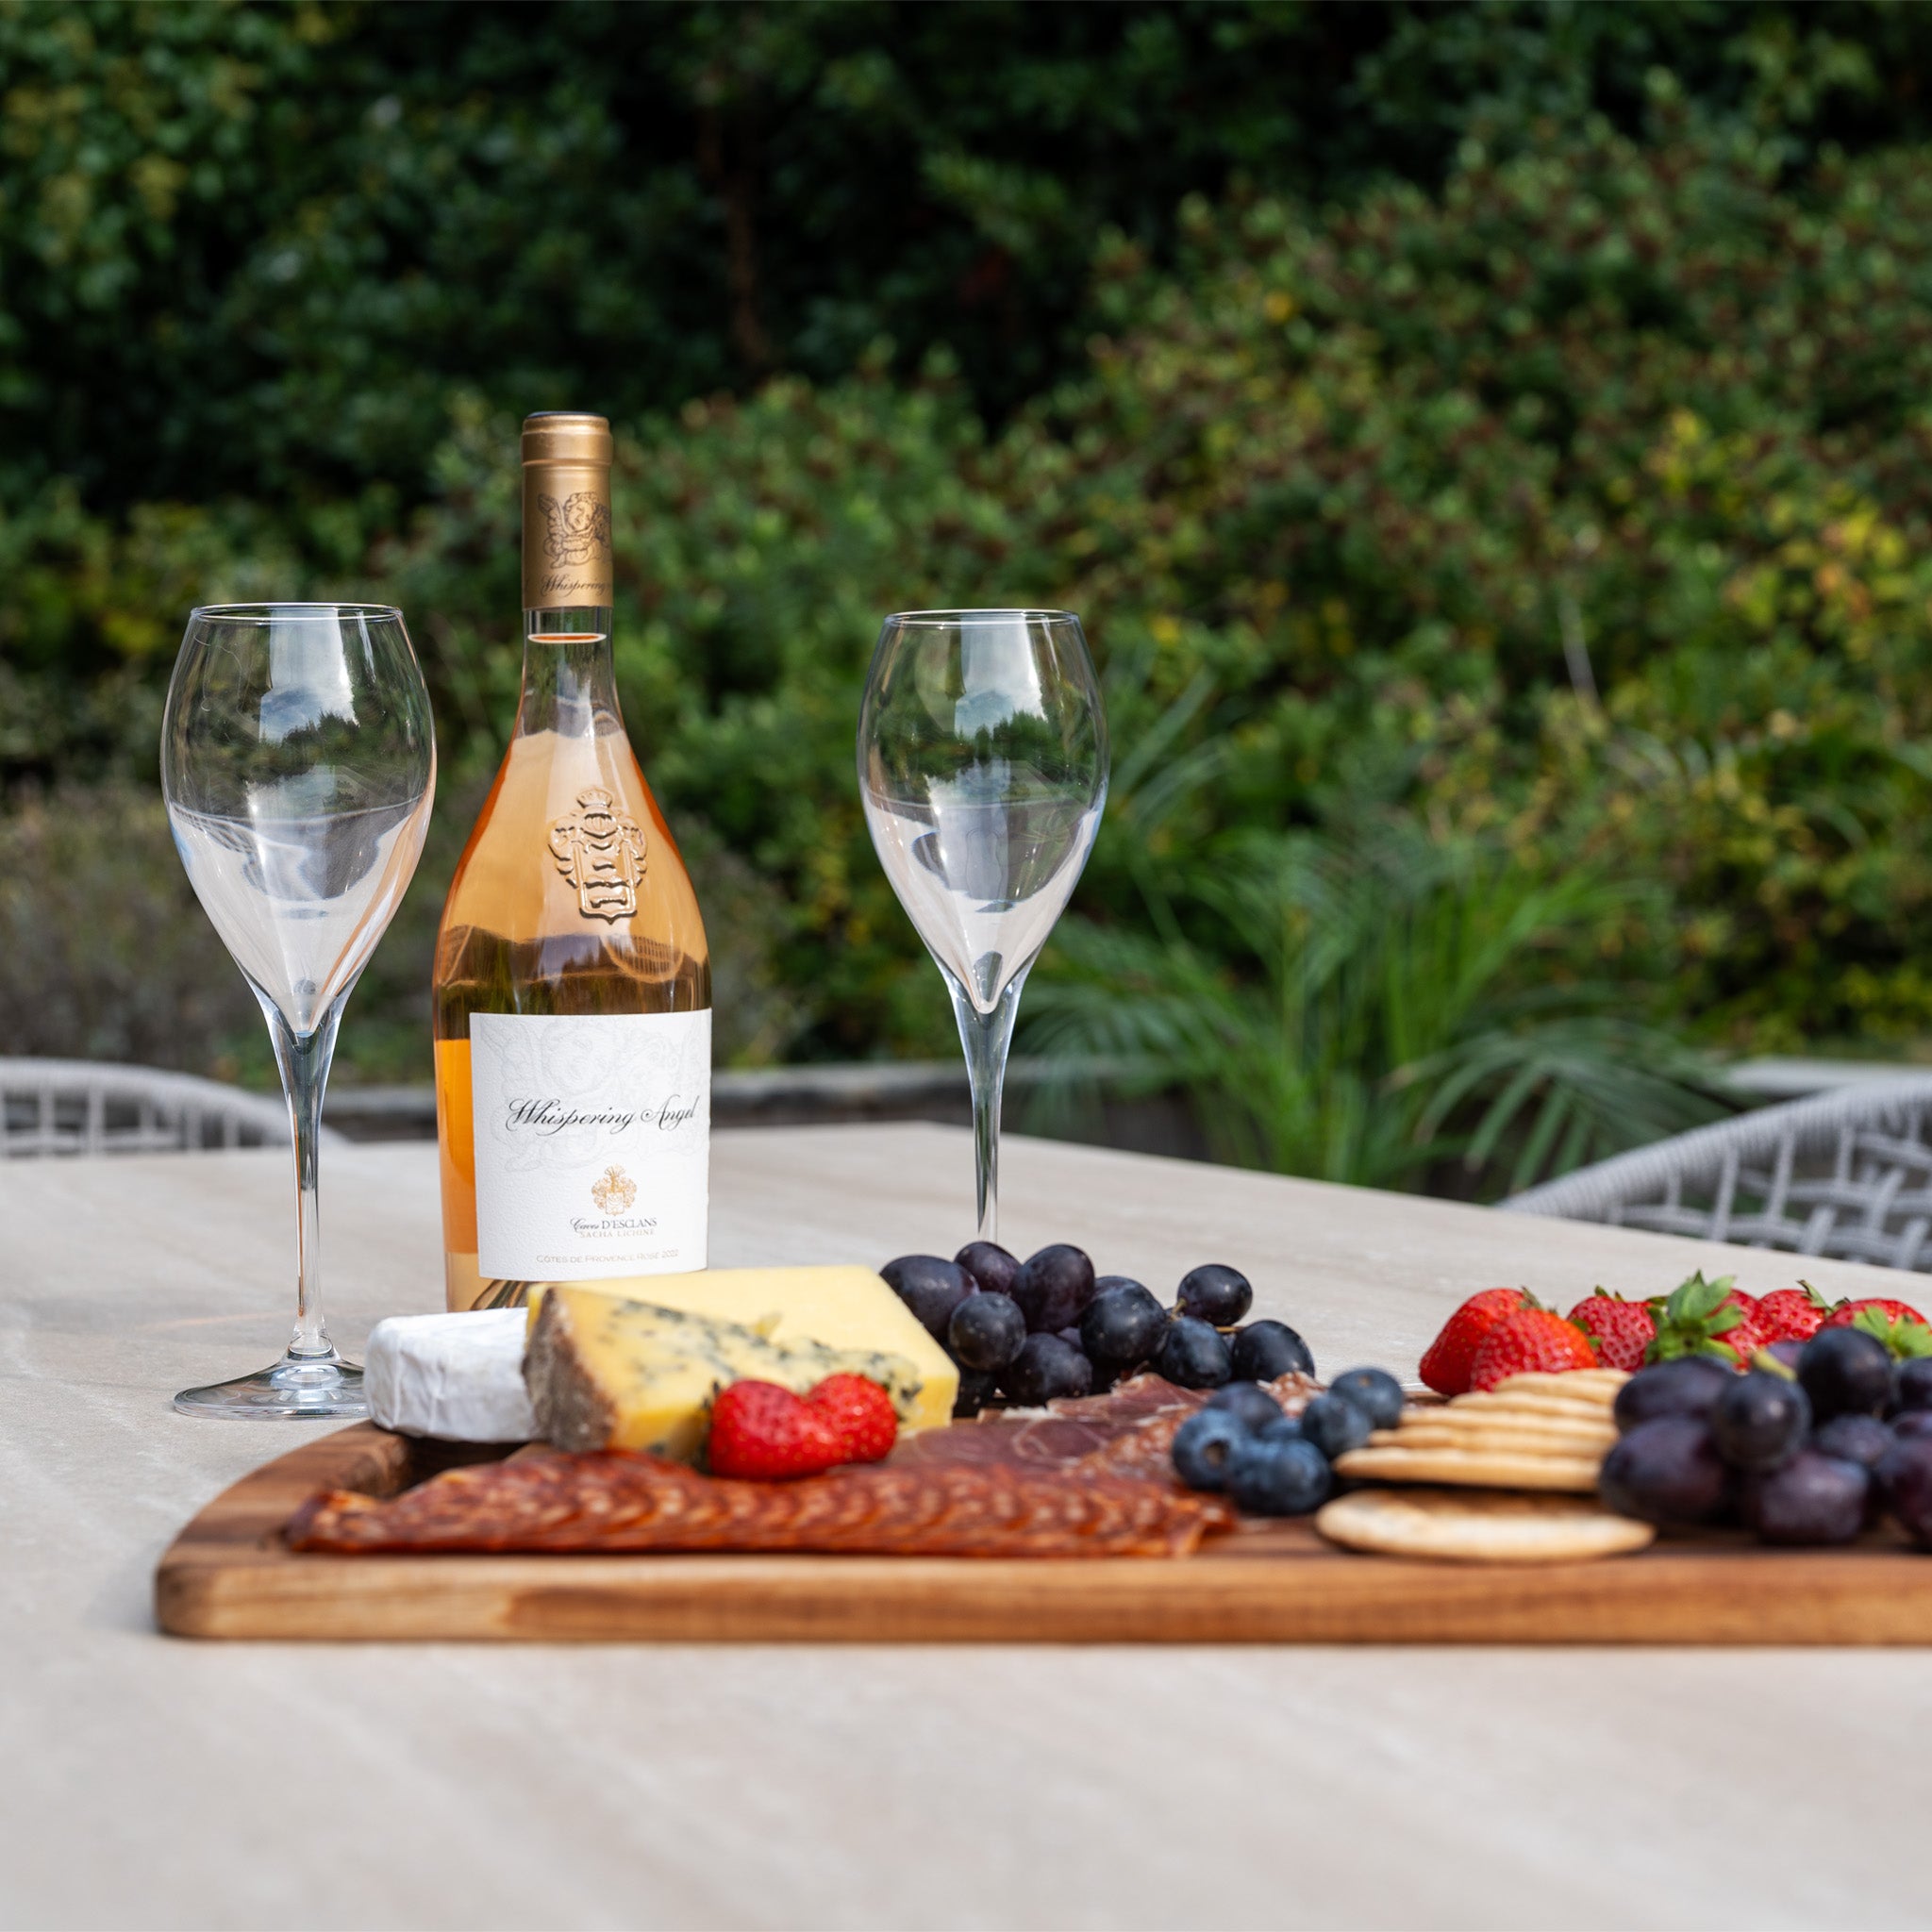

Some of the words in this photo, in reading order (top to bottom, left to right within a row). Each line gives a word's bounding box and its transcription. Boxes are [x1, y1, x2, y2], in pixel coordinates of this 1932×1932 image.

[541, 574, 605, 598] Whispering
[506, 1098, 636, 1136] Whispering
[641, 1094, 700, 1131] Angel
[570, 1218, 600, 1233] Caves
[580, 1230, 613, 1239] SACHA
[570, 1255, 583, 1263] DE
